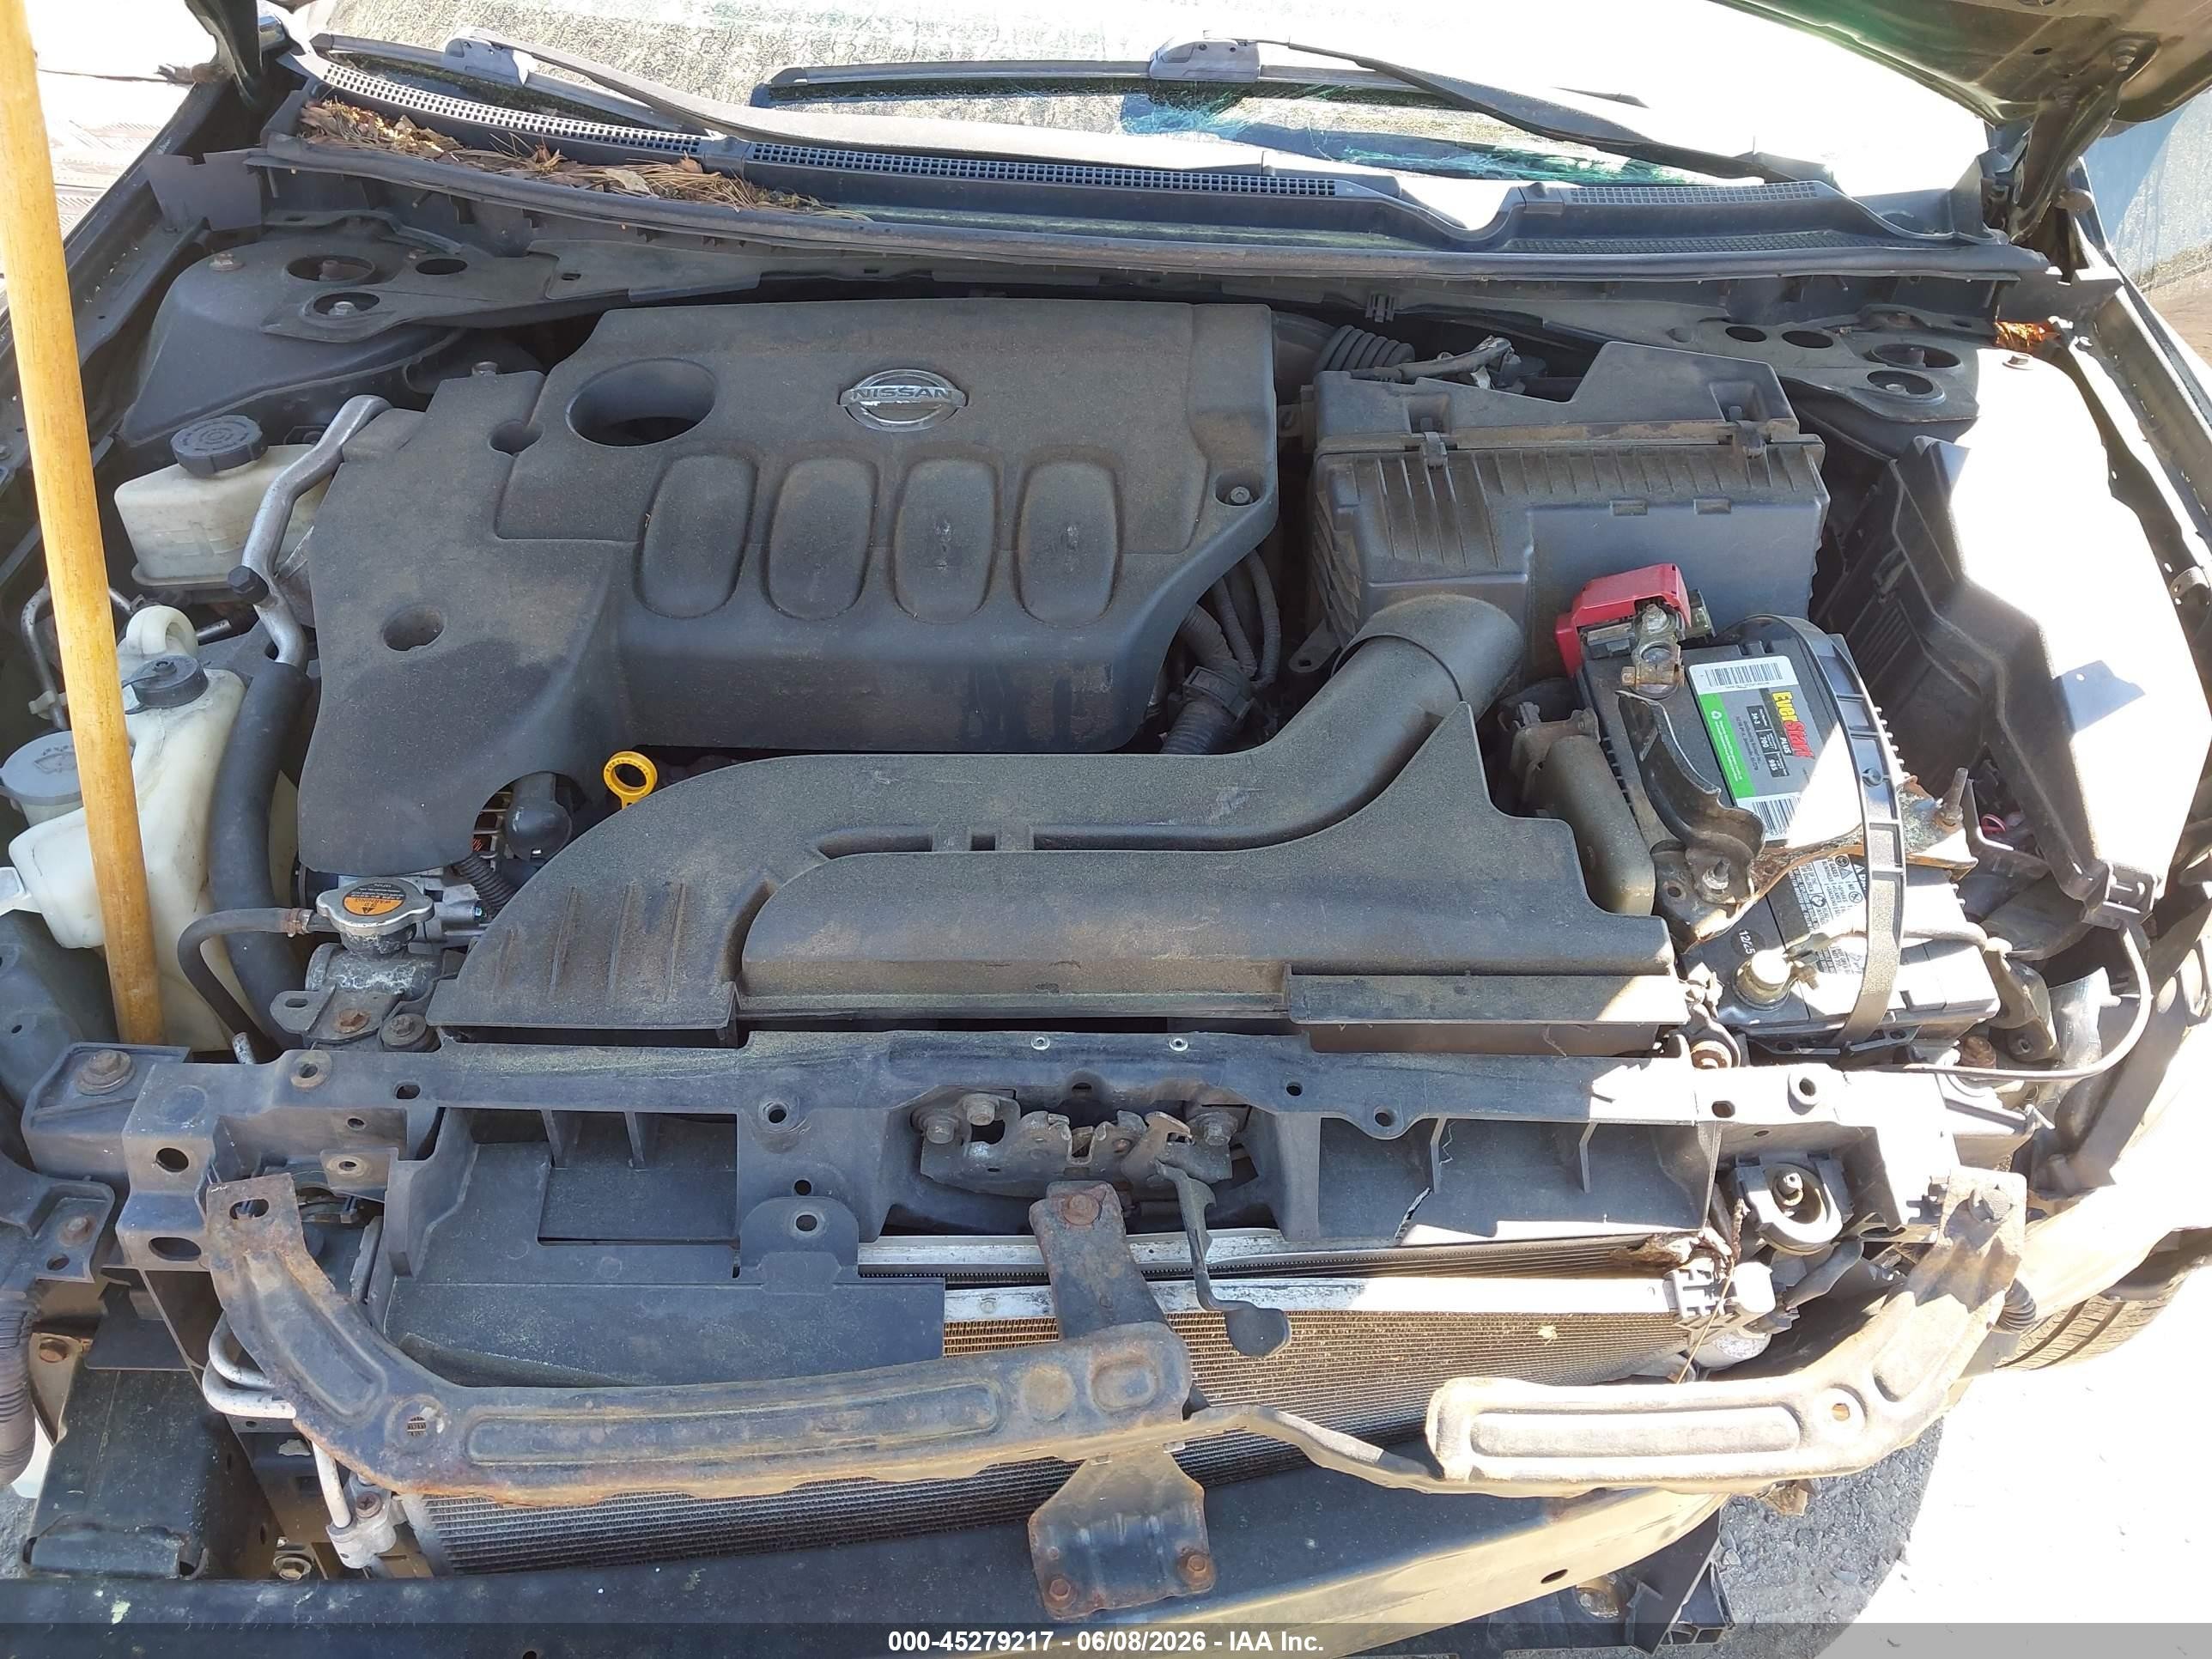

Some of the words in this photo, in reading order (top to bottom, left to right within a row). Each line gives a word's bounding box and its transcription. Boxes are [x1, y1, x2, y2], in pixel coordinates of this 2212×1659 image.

[853, 387, 952, 399] NISSAN
[1772, 690, 1814, 758] EverStart
[1759, 736, 1769, 748] 700
[1780, 737, 1791, 754] PLUS
[1738, 930, 1756, 955] 12/25
